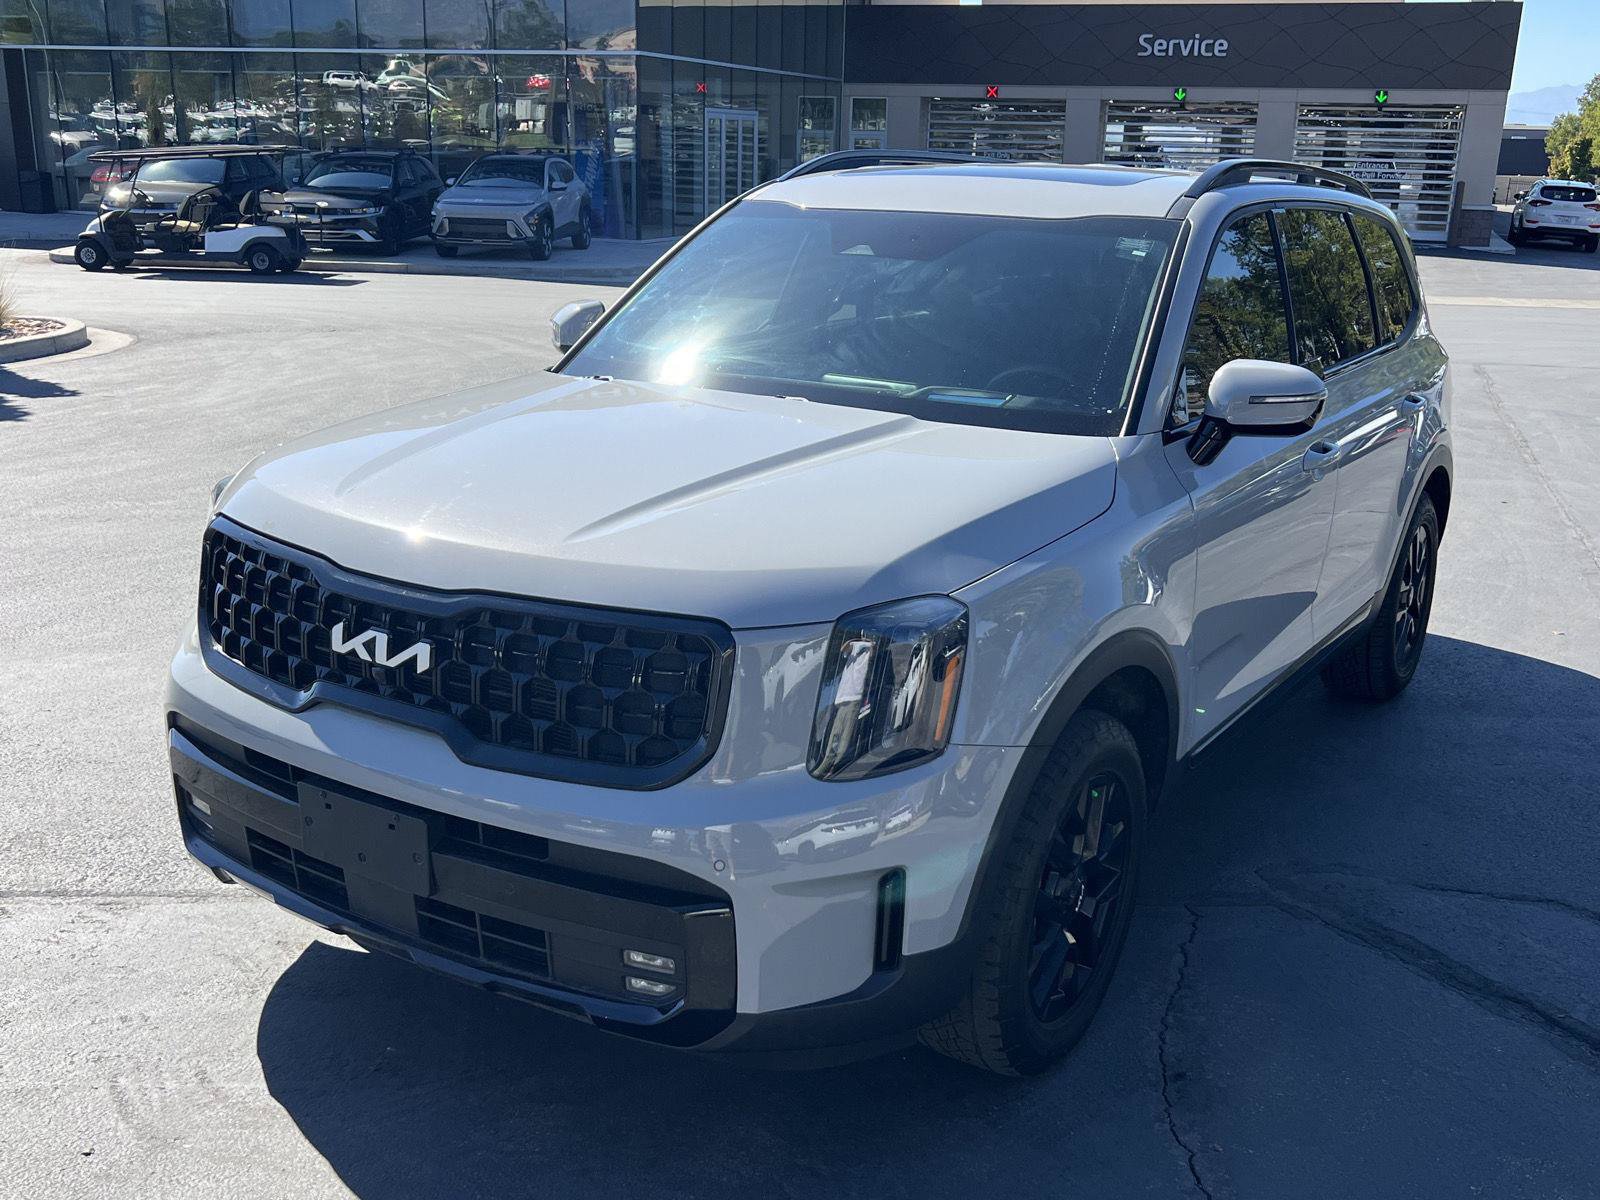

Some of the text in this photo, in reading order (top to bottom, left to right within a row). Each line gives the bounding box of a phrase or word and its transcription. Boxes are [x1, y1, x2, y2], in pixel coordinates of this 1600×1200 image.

[1137, 33, 1229, 57] Service
[1356, 161, 1389, 169] Entrance
[331, 620, 431, 674] KIA
